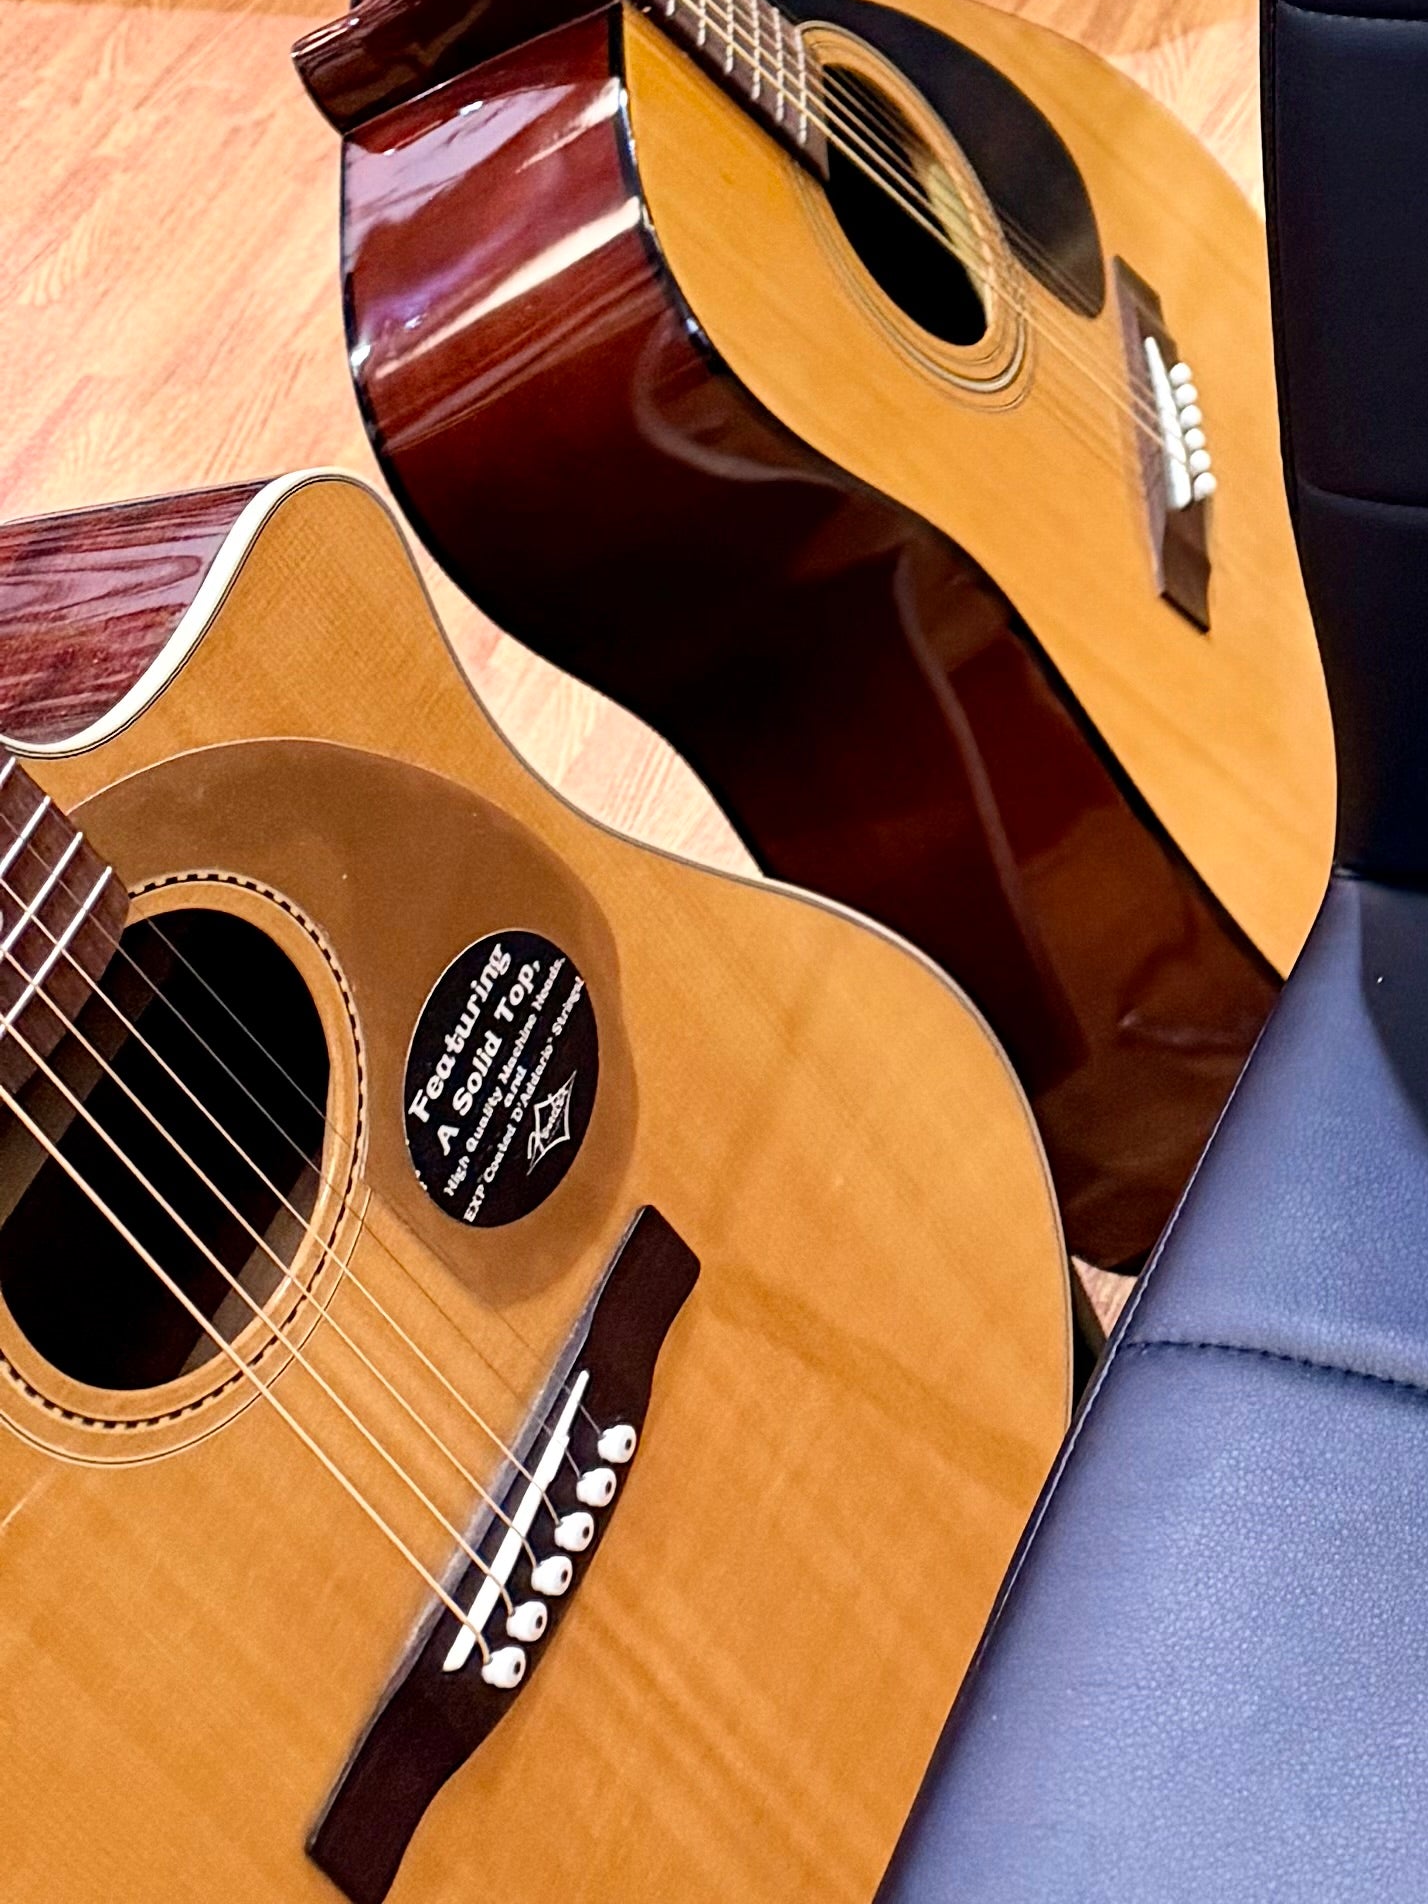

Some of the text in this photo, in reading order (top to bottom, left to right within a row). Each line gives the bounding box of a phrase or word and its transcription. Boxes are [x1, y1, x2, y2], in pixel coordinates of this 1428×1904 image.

[408, 943, 512, 1123] Featuring
[436, 959, 542, 1157] A Solid Top,
[443, 1155, 471, 1197] High
[465, 1085, 504, 1153] Quality
[498, 1013, 537, 1086] Machine
[503, 1065, 528, 1108] and
[463, 1183, 486, 1224] EXP
[483, 1124, 517, 1184] Coated
